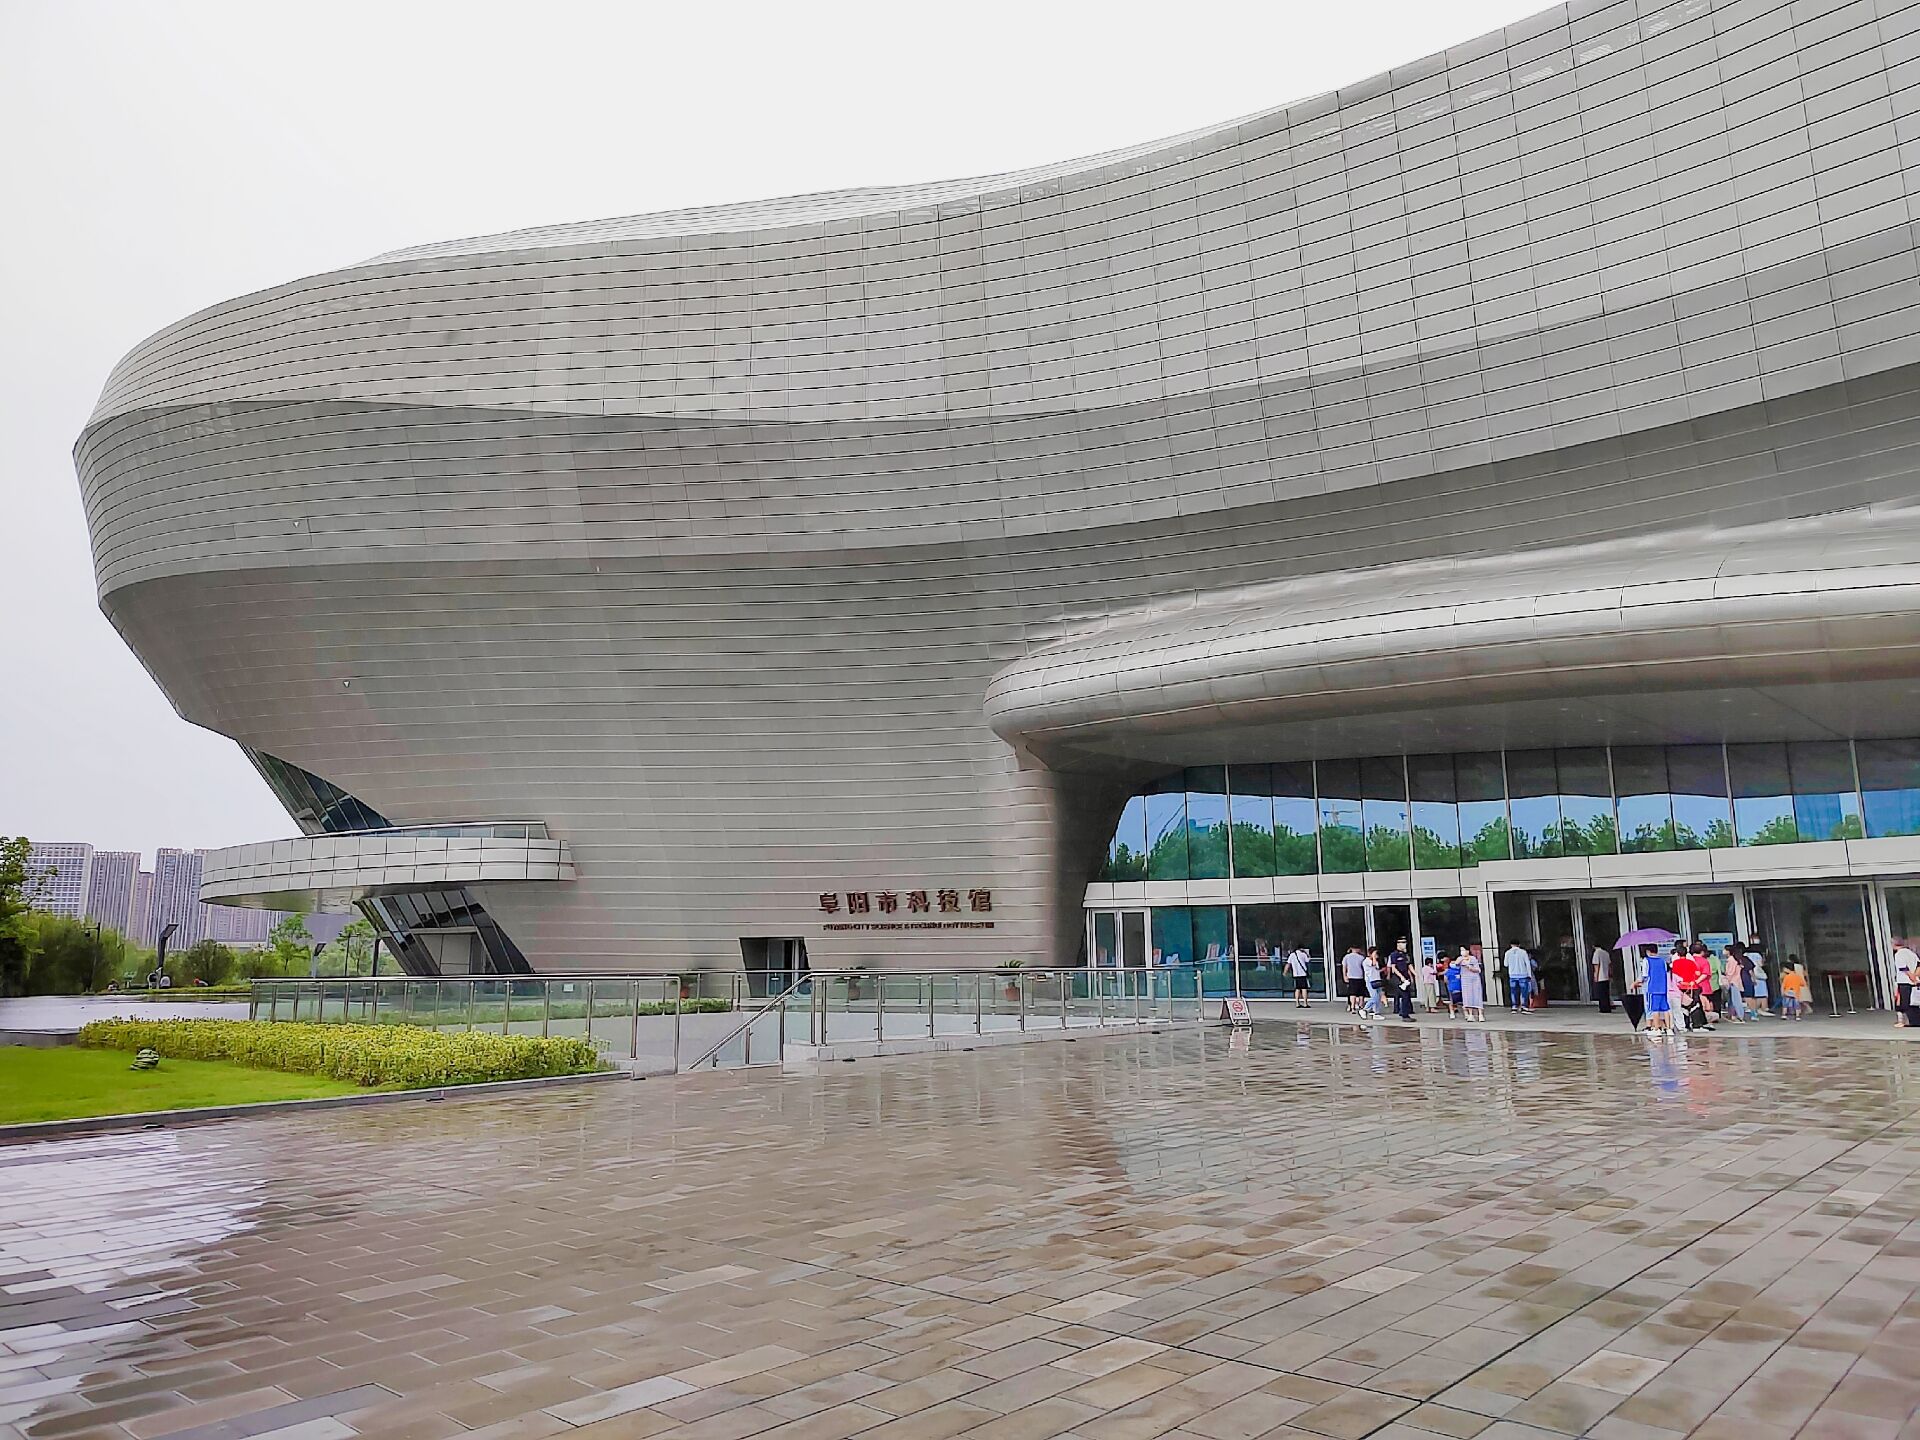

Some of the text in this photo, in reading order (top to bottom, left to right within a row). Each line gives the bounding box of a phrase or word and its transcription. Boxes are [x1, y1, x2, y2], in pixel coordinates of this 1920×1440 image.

[819, 888, 992, 915] 阜阳市科技馆
